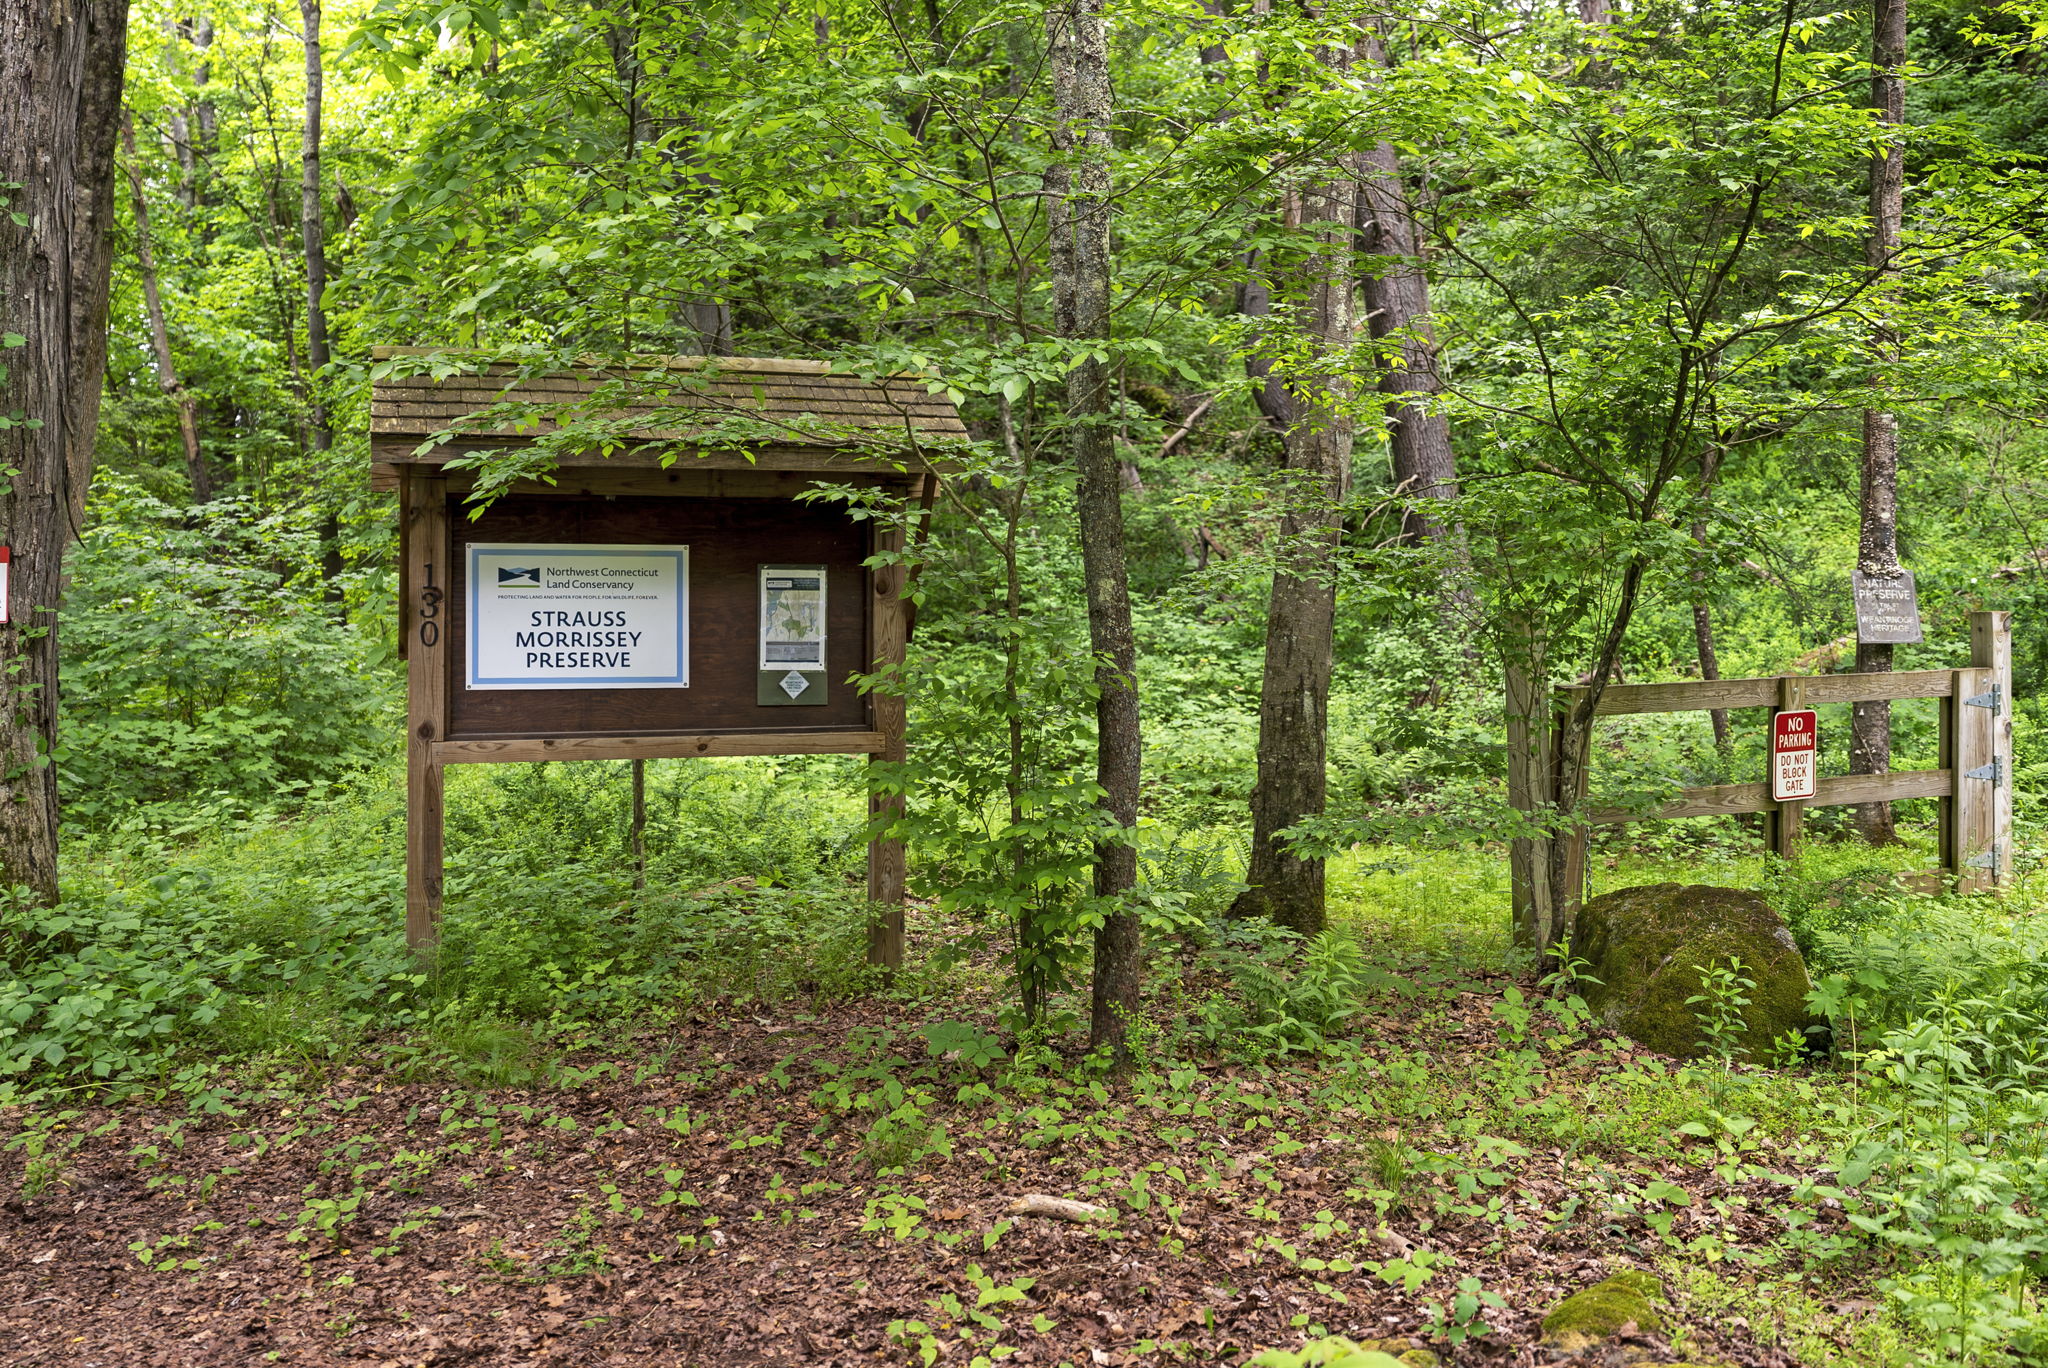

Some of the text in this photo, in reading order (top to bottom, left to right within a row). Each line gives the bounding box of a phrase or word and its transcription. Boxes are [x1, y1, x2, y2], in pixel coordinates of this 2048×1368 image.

[546, 567, 659, 577] Northwest Connecticut
[546, 579, 634, 591] Land Conservancy
[1863, 578, 1904, 588] NATURE
[1858, 589, 1911, 600] PRESERVE
[420, 563, 439, 648] 130
[531, 611, 626, 627] STRAUSS
[516, 631, 642, 648] MORRISSEY
[526, 652, 631, 668] PRESERVE
[1788, 717, 1803, 732] NO
[1779, 732, 1812, 748] PARKING
[1781, 754, 1809, 766] DO NOT
[1782, 766, 1807, 779] BLOCK
[1785, 780, 1804, 791] GATE
